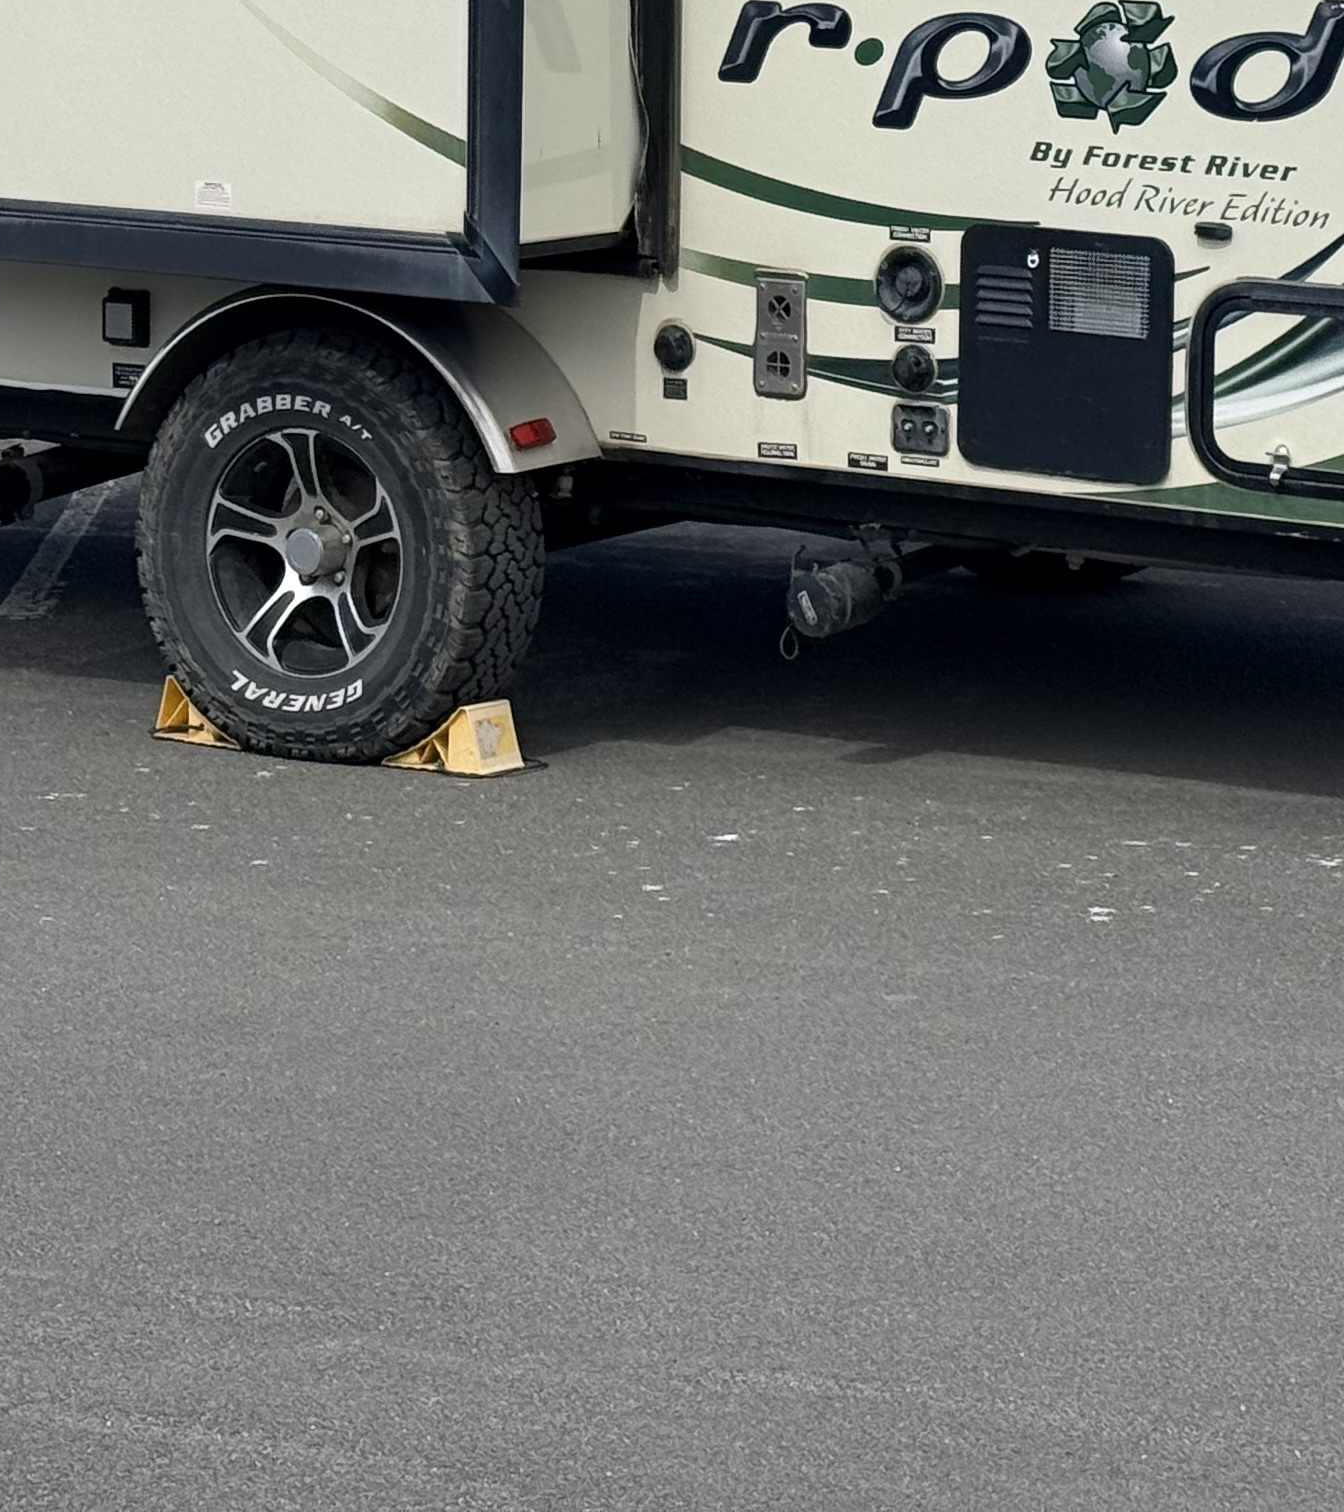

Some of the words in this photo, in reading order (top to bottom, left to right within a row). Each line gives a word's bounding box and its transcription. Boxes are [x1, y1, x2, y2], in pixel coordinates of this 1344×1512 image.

[1029, 141, 1073, 169] By
[1082, 145, 1197, 173] Forest
[1205, 155, 1298, 182] River
[1048, 177, 1133, 209] Hood
[1134, 184, 1215, 218] River
[1220, 191, 1331, 230] Edition
[204, 394, 331, 449] GRABBER
[339, 414, 373, 440] A/T
[231, 669, 363, 713] GENERAL
